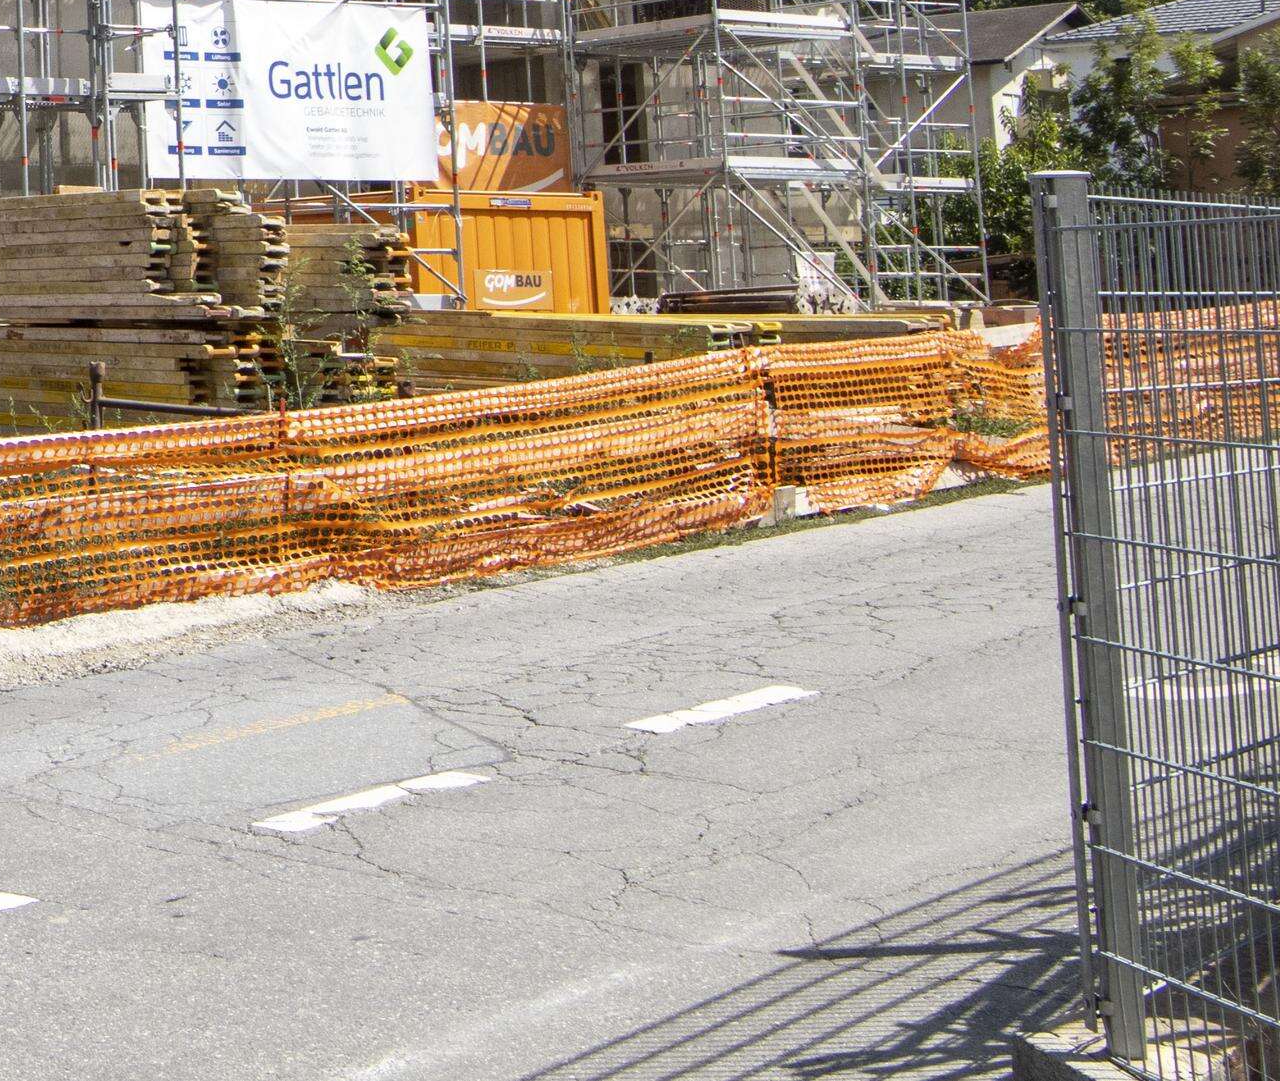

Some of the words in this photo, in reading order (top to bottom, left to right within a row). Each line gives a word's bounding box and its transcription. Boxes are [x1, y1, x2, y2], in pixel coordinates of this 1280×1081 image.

[268, 60, 385, 101] Gattlen
[438, 121, 556, 170] OMBAU
[484, 273, 542, 293] GOMBAU
